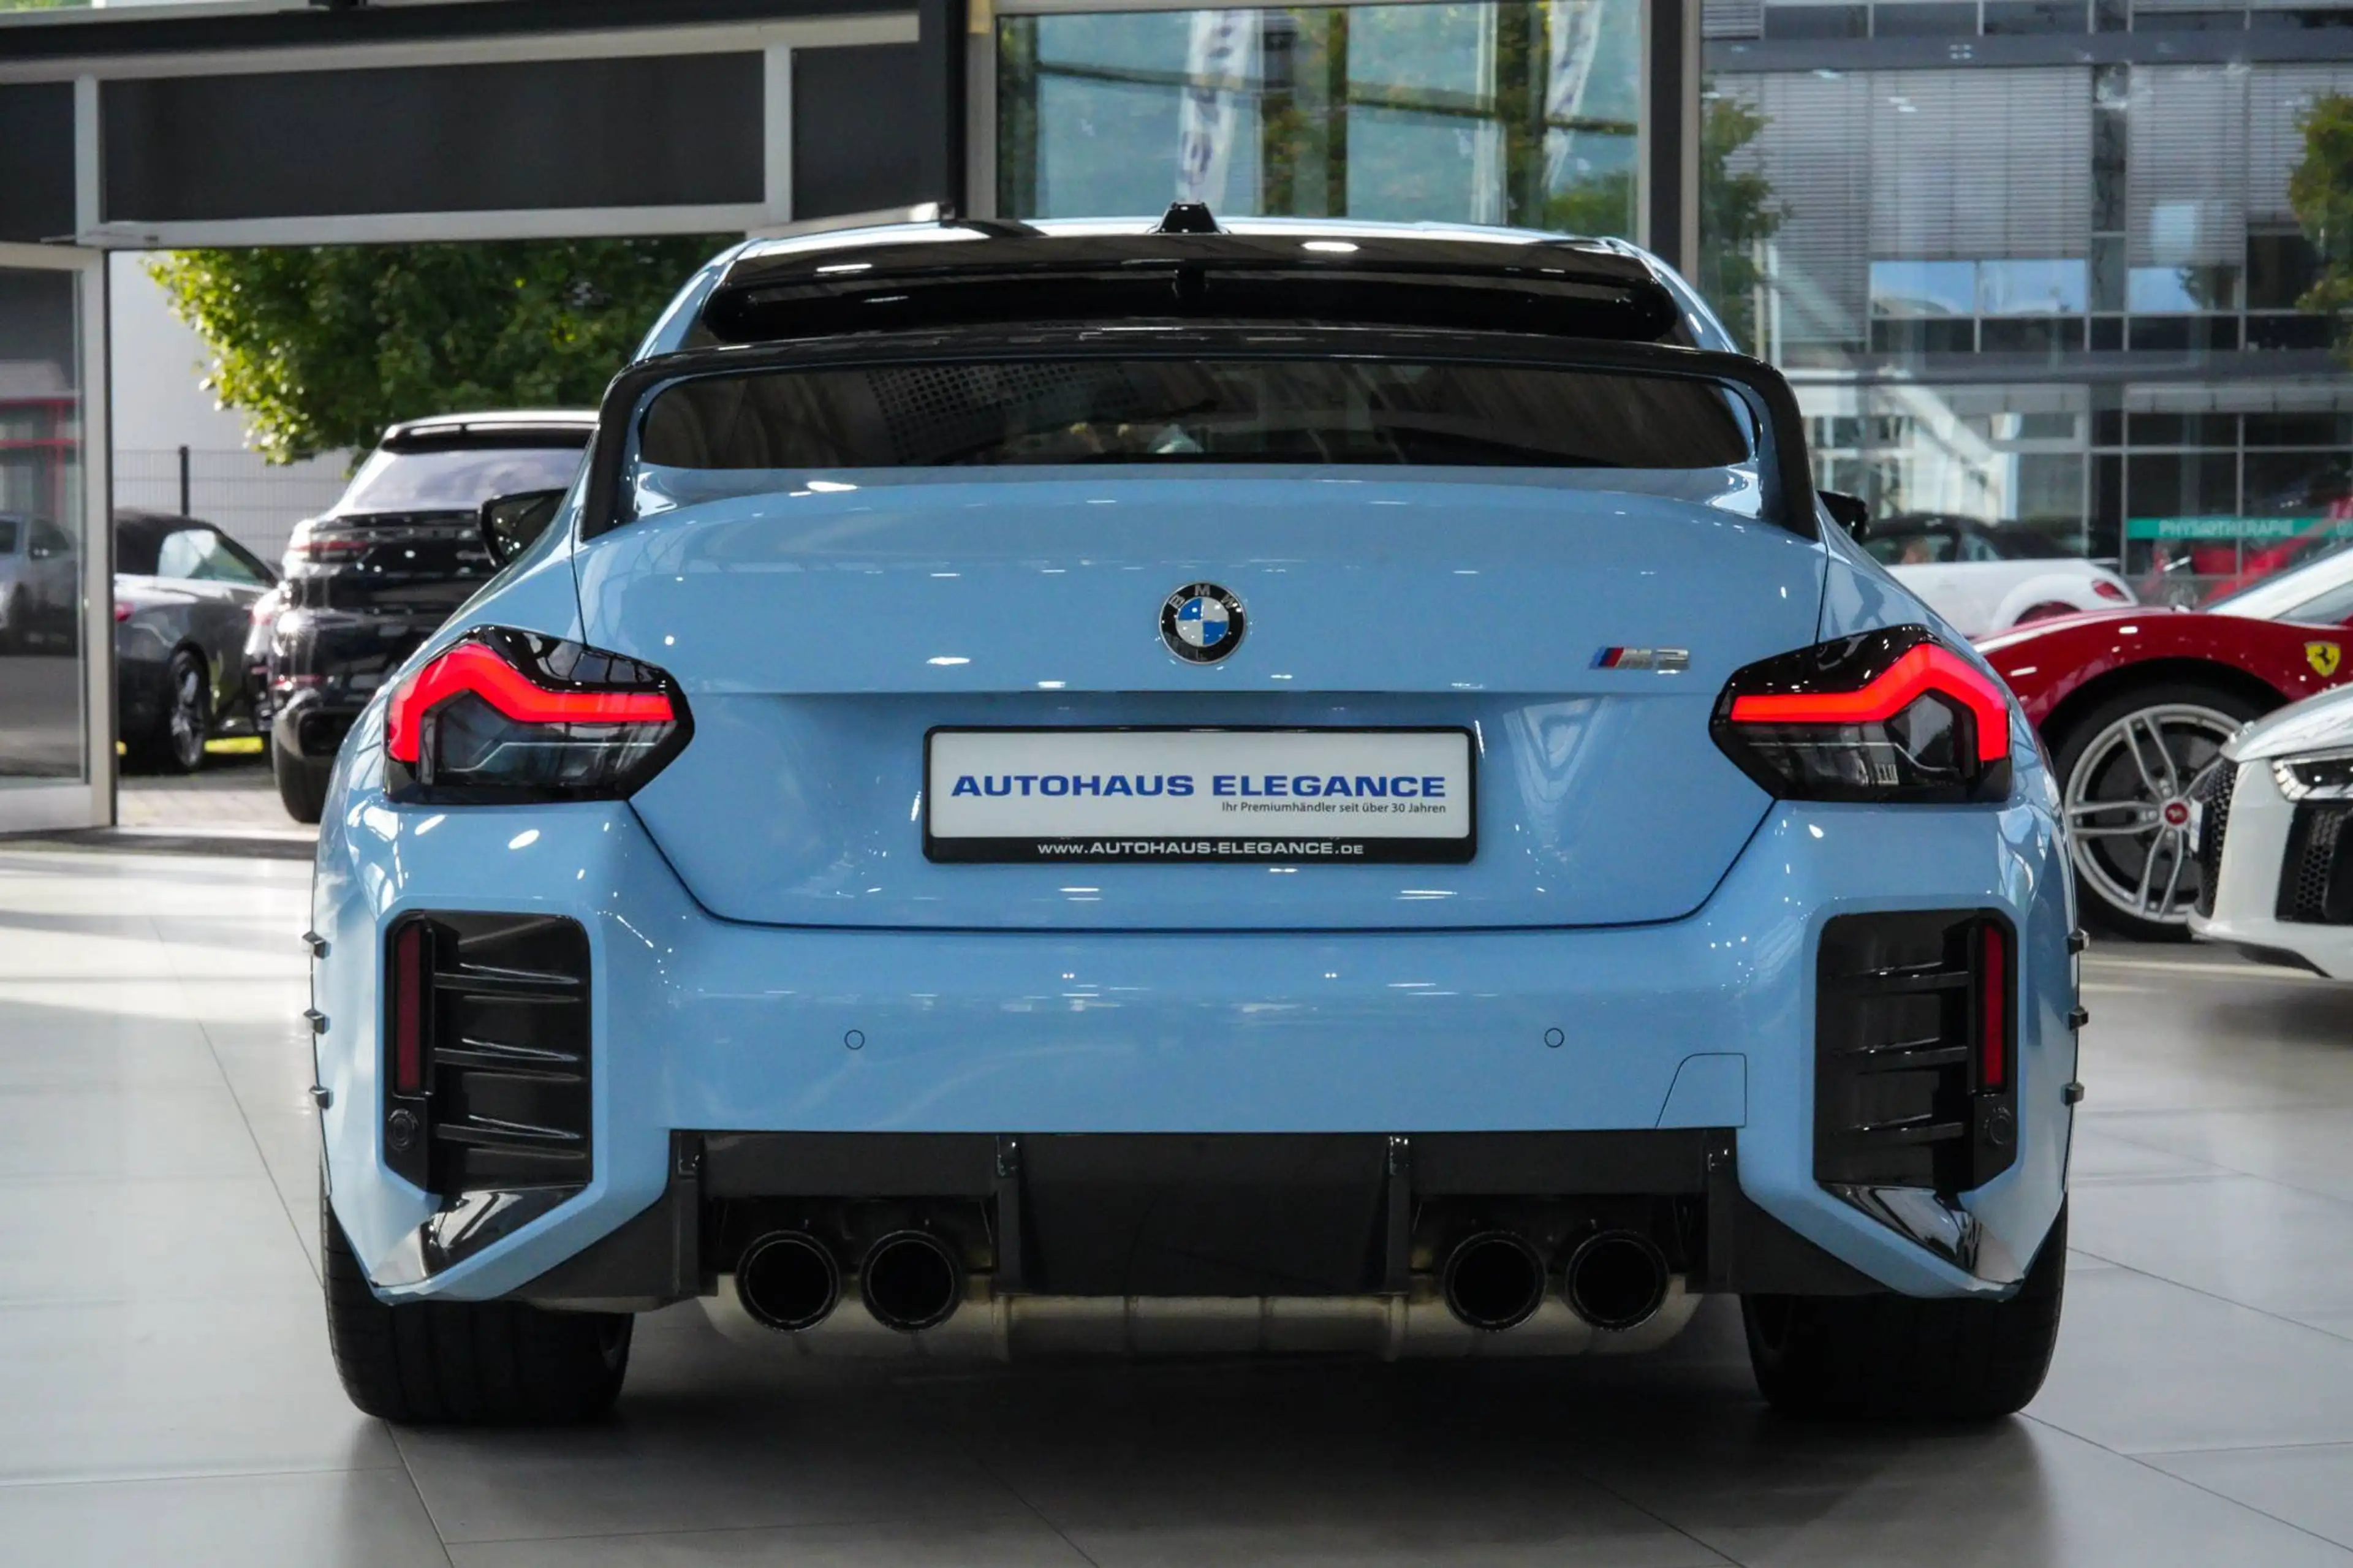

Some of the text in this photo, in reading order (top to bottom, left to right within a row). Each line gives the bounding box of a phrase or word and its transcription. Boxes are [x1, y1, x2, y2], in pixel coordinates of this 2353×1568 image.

[1168, 585, 1238, 609] BMW
[951, 775, 1446, 798] AUTOHAUS ELEGANCE
[1222, 801, 1446, 814] Ihr Premiumhändler seit über 30 Jahren
[1037, 841, 1364, 855] www.AUTOHAUS-ELEGANCE.DE
